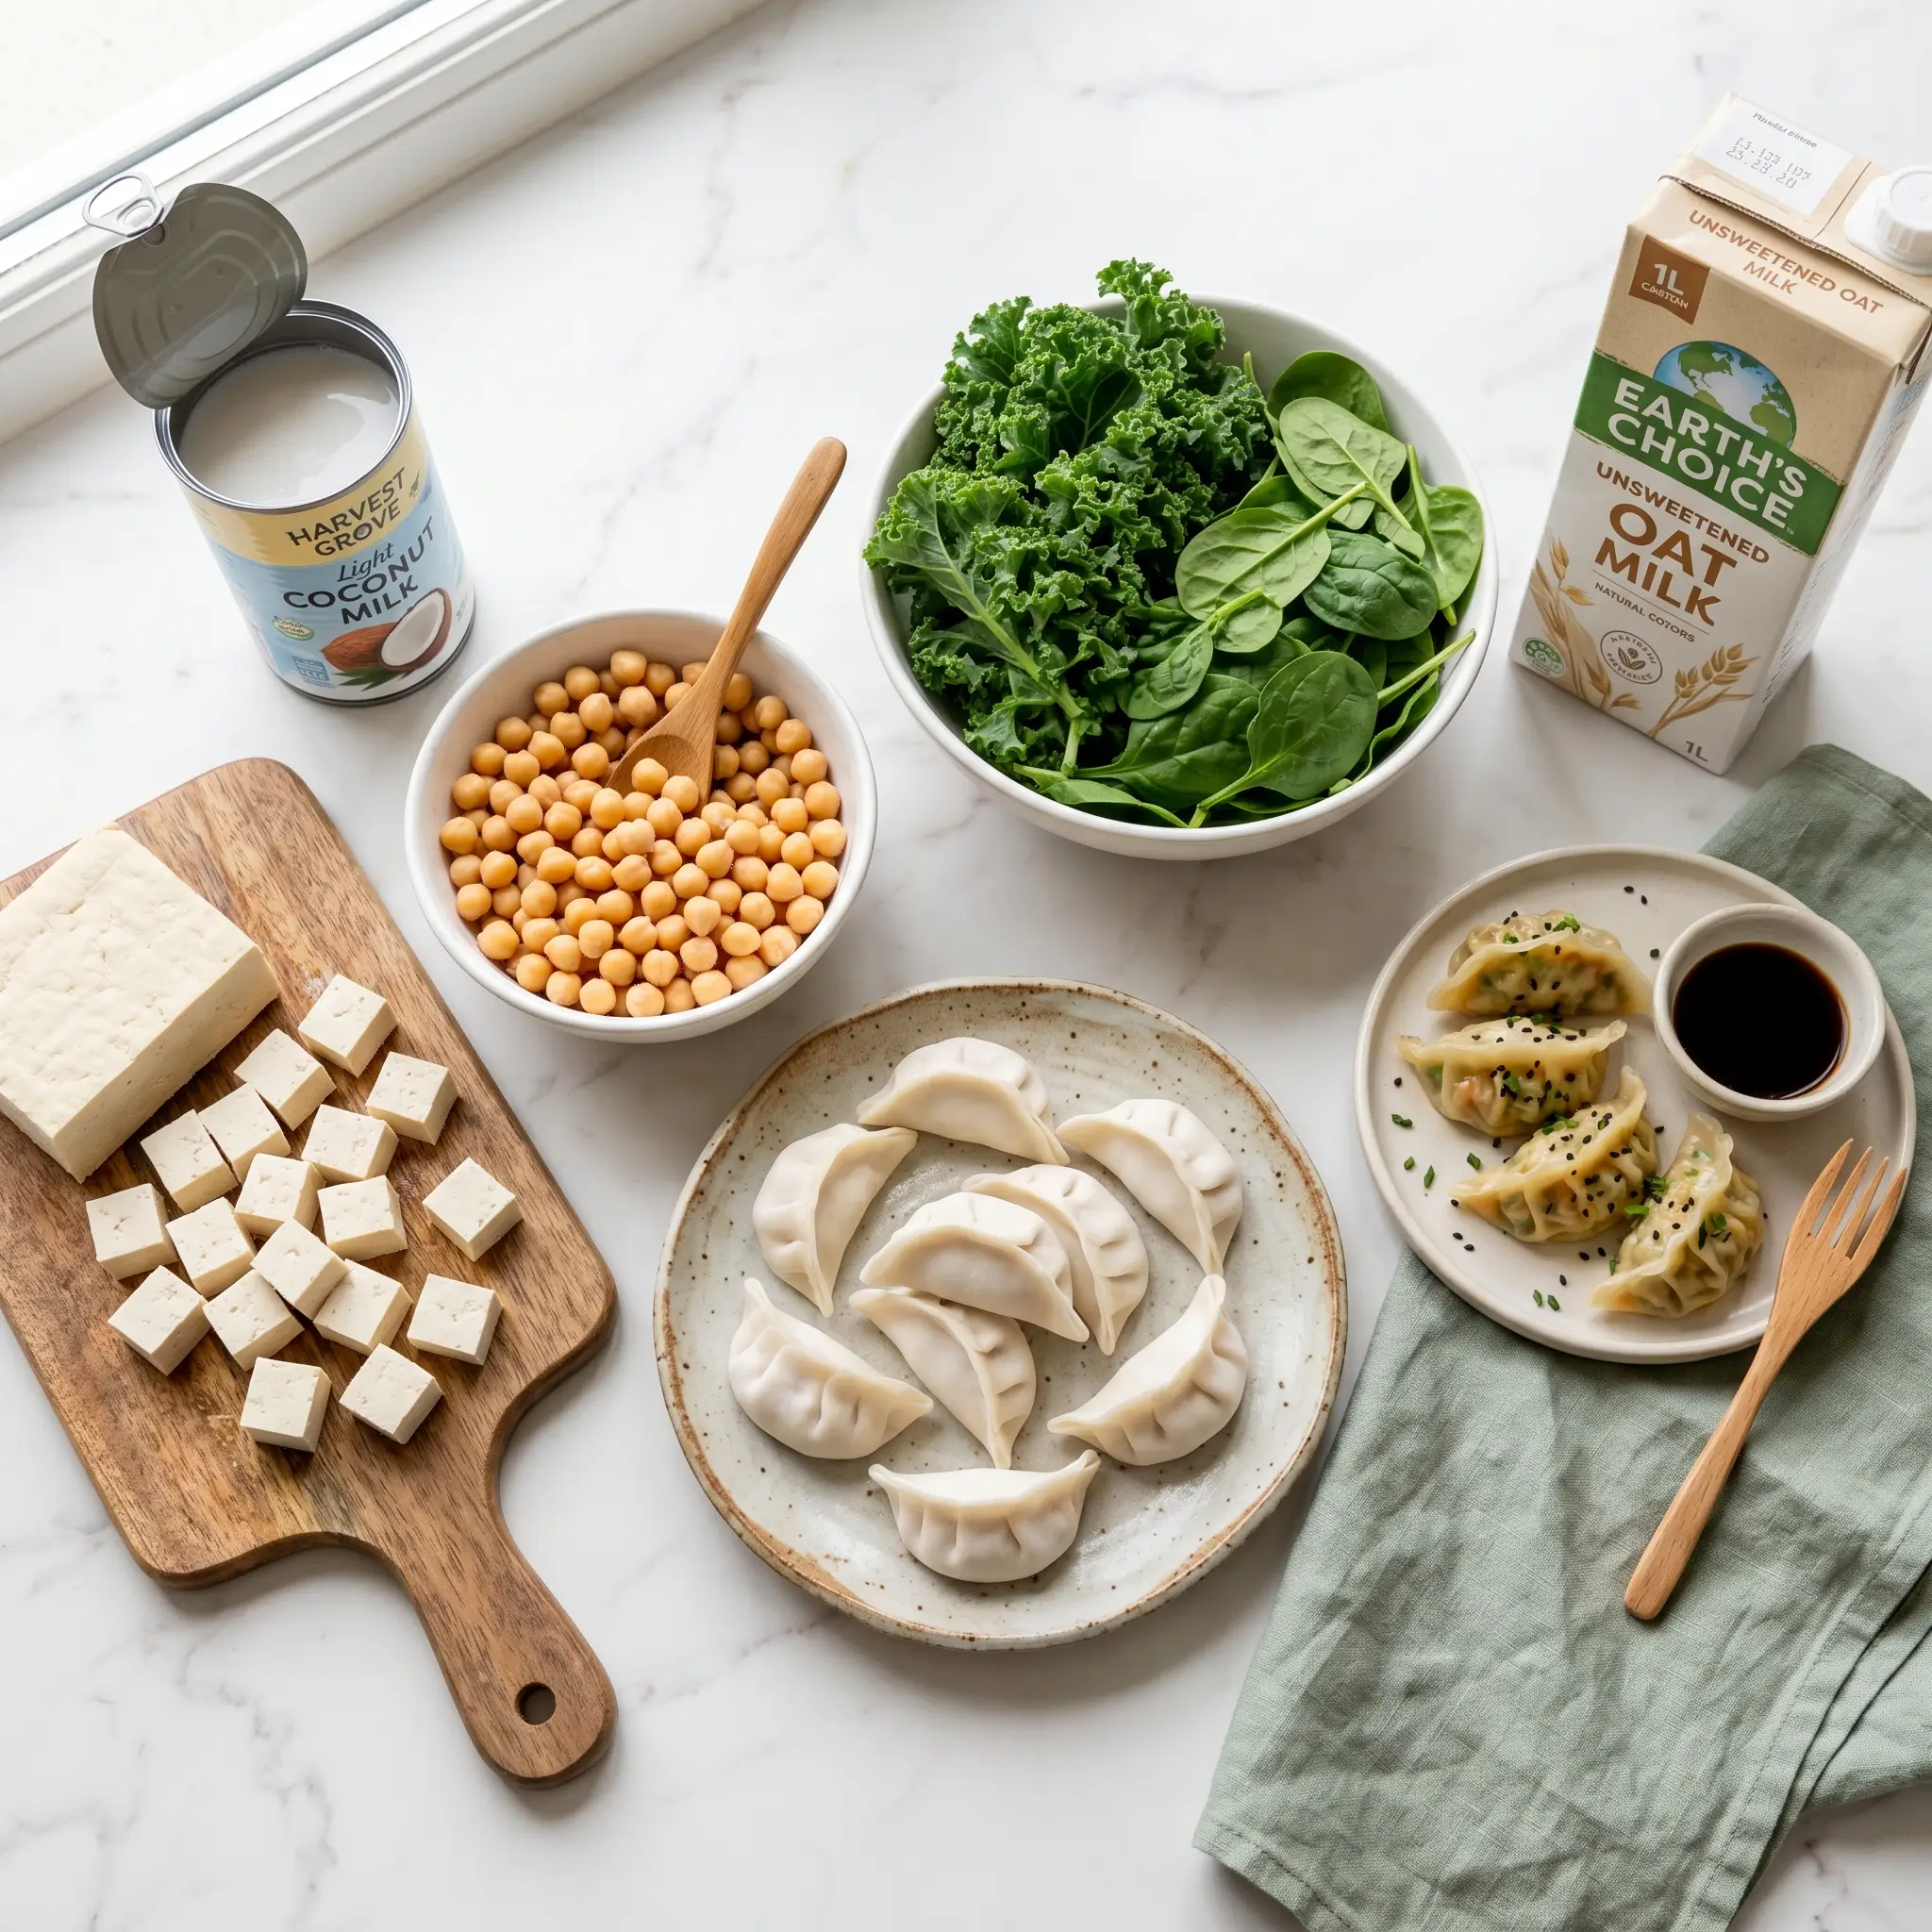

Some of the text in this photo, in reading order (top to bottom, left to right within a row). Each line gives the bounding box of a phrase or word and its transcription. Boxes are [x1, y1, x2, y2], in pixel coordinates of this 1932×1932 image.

[1654, 263, 1684, 295] 1L
[1689, 209, 1884, 315] UNSWEETENED OAT
[1742, 260, 1799, 294] MILK
[1607, 412, 1794, 529] CHOICE
[1613, 377, 1808, 498] EARTH'S
[287, 467, 406, 546] HARVEST
[314, 500, 401, 557] GROVE
[1596, 460, 1770, 564] UNSWEETENED
[1608, 503, 1738, 589] OAT
[283, 516, 434, 608] COCONUT
[337, 542, 394, 582] Light
[341, 575, 419, 625] MILK
[1594, 537, 1722, 627] MILK
[1594, 581, 1645, 617] NATURAL
[1685, 741, 1708, 763] 1L
